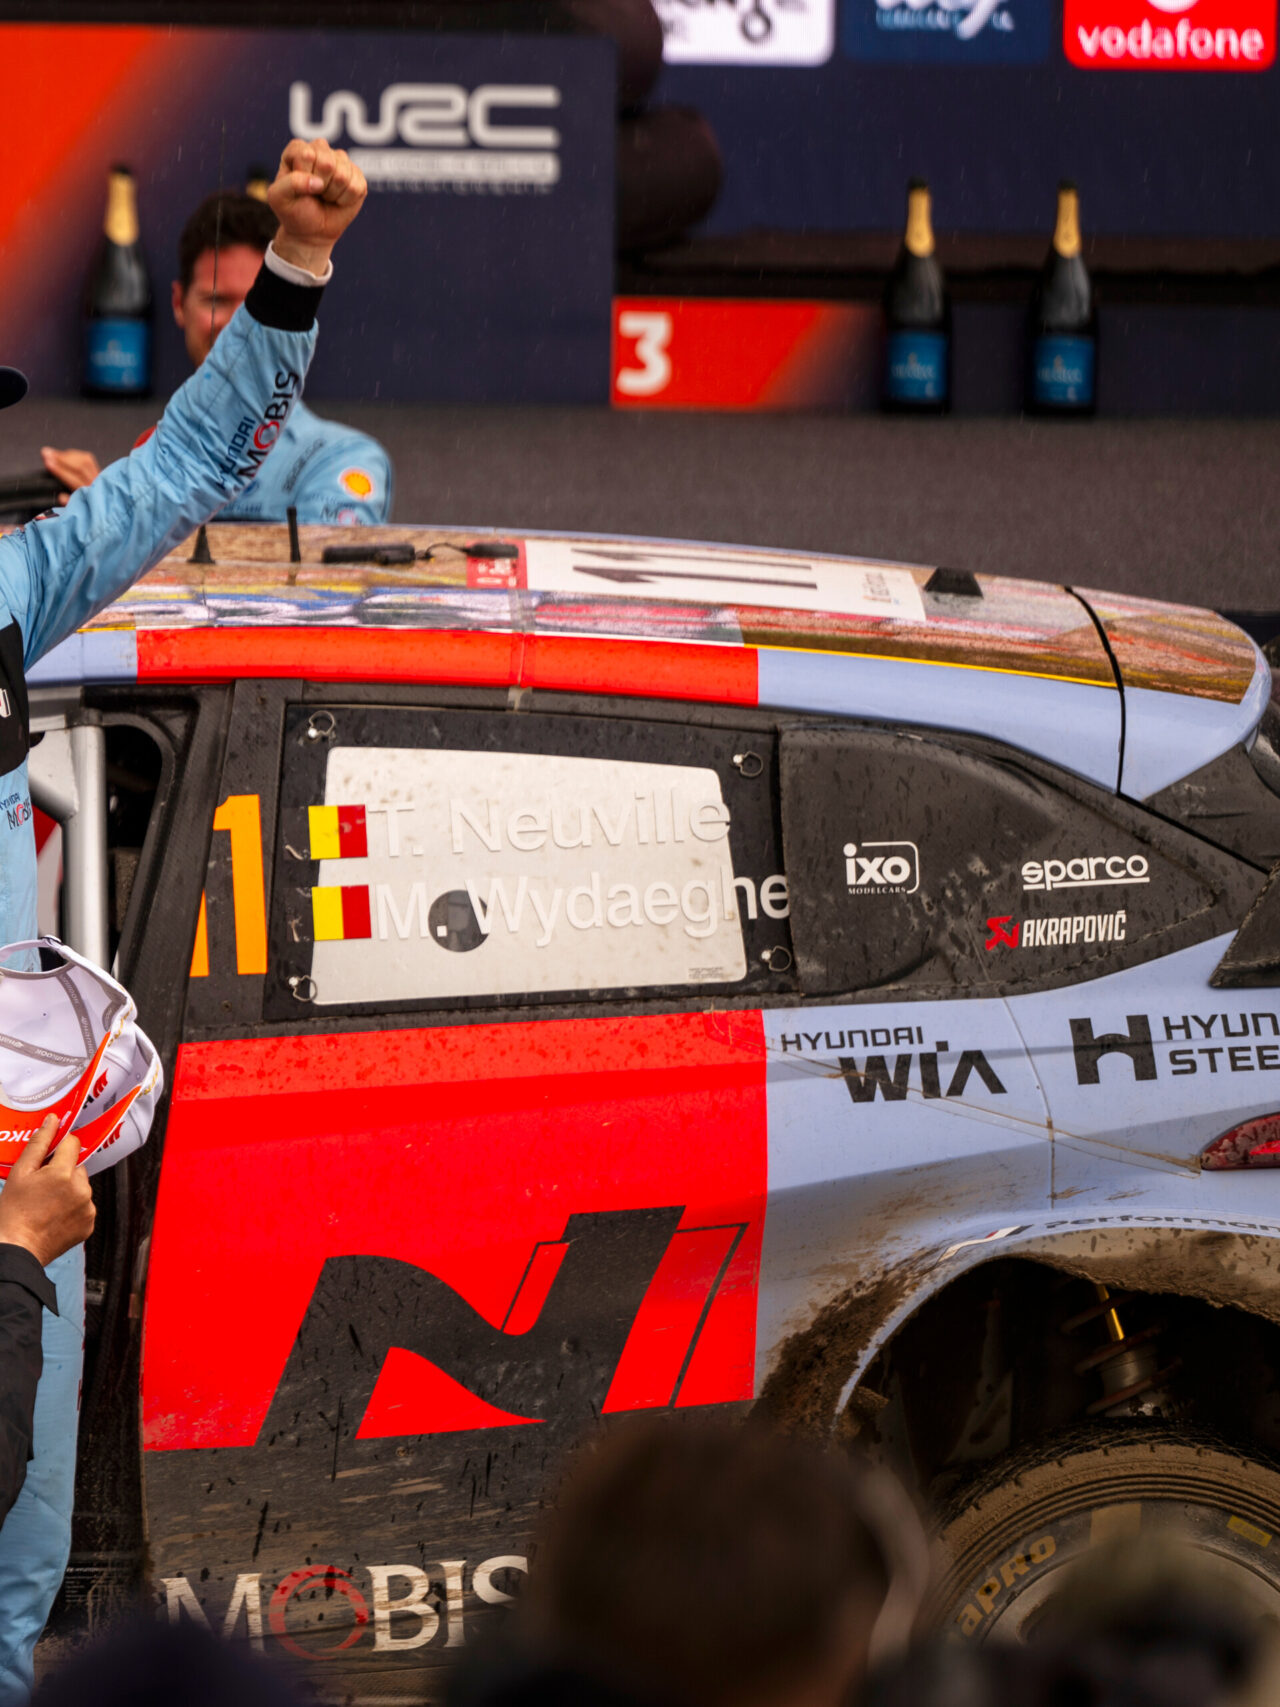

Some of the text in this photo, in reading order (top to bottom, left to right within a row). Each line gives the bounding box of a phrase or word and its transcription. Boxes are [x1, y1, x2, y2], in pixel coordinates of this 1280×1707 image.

[1077, 19, 1266, 61] vodafone
[289, 80, 561, 149] WRC
[616, 311, 673, 396] 3
[238, 371, 300, 479] MOBIS
[369, 788, 732, 858] T. Neuville
[842, 843, 912, 886] ixo
[847, 885, 908, 896] MODELCARS
[1022, 854, 1150, 891] sparco
[375, 866, 791, 948] M. Wydaeghe
[1021, 909, 1127, 948] AKRAPOVIČ
[780, 1025, 924, 1053] HYUNDAI
[160, 1554, 532, 1661] MOBIS
